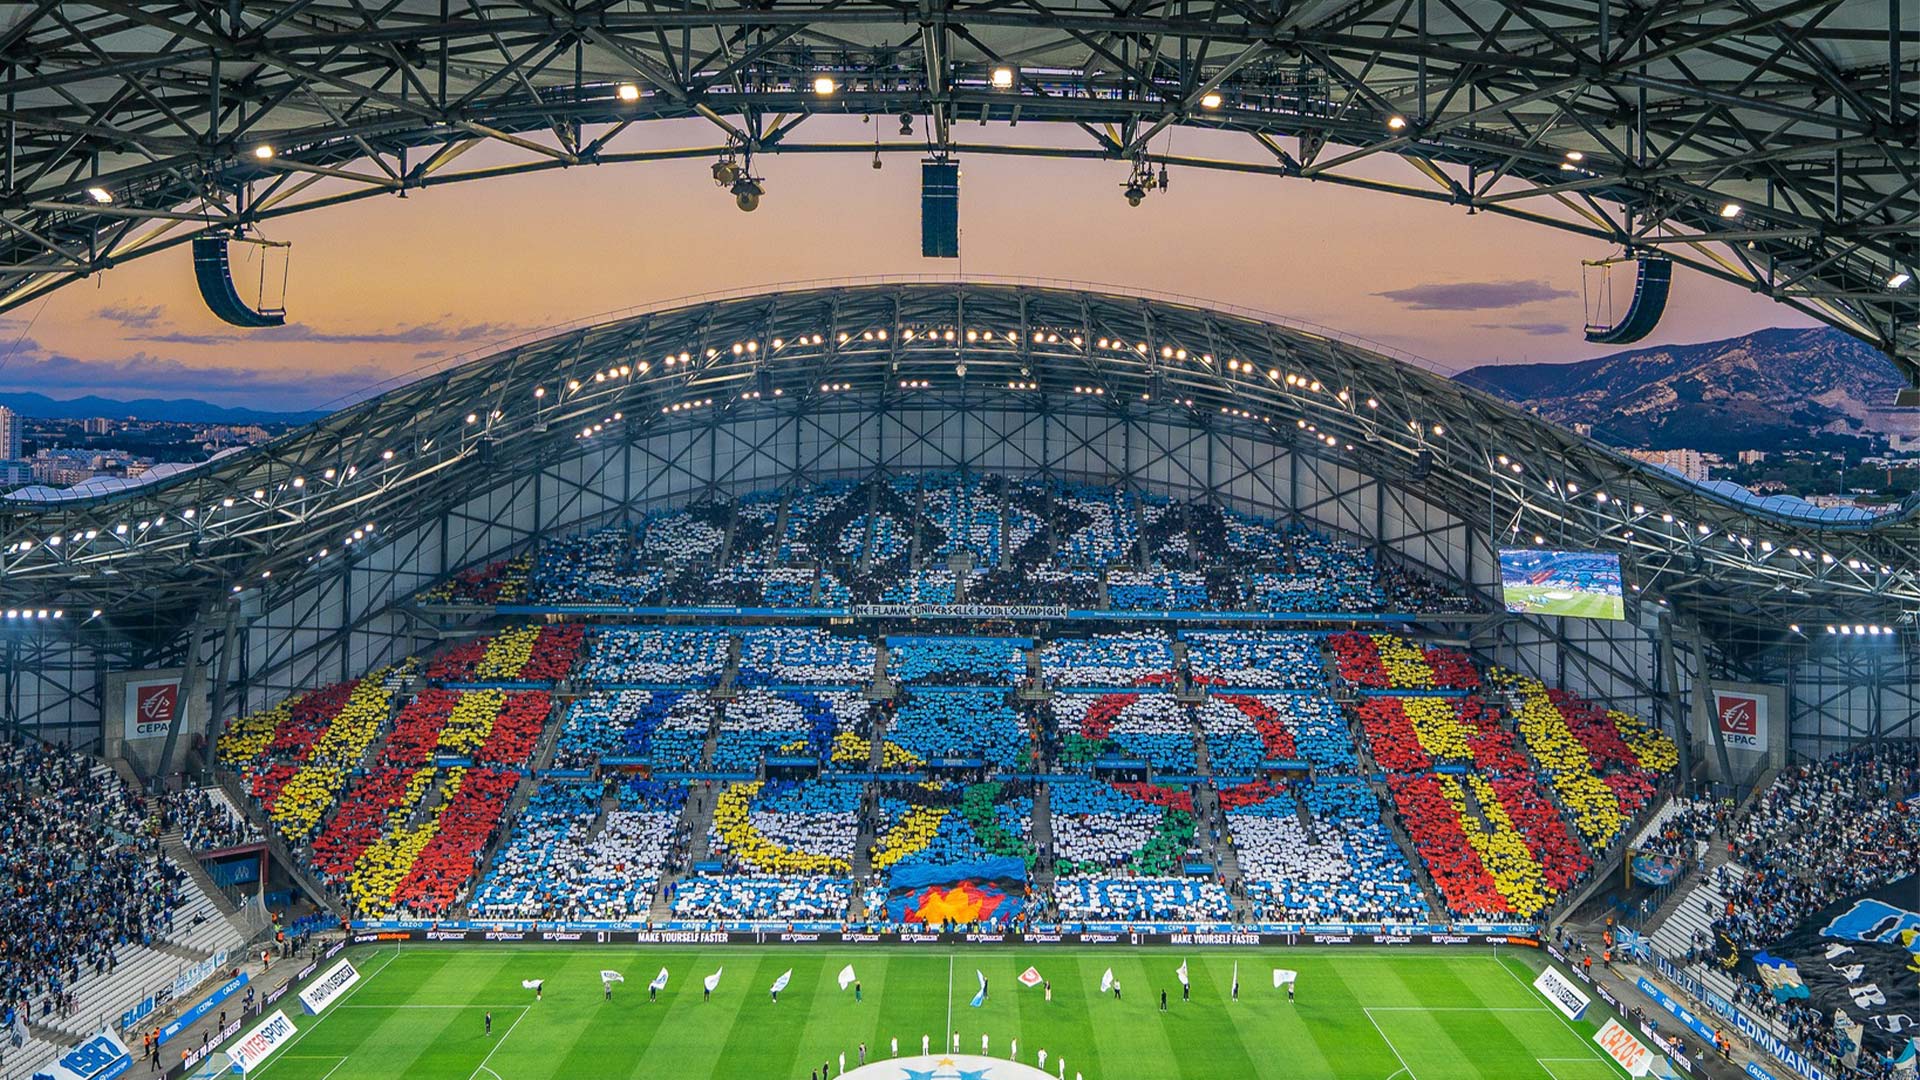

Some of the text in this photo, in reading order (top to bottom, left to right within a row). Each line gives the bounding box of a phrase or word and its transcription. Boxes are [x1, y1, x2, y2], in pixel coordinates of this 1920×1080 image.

[851, 606, 869, 614] UNE
[873, 606, 913, 615] FLAMME
[915, 605, 974, 615] UNIVERSELLE
[978, 606, 1003, 615] POUR
[1004, 606, 1066, 615] L'OLYMPIQUE
[137, 722, 170, 734] CEPA
[638, 933, 728, 943] MAKE YOURSELF FASTER
[1171, 934, 1259, 944] MAKE YOURSELF FASTER
[240, 1016, 291, 1061] INTERSPORT
[60, 1036, 122, 1078] 1987
